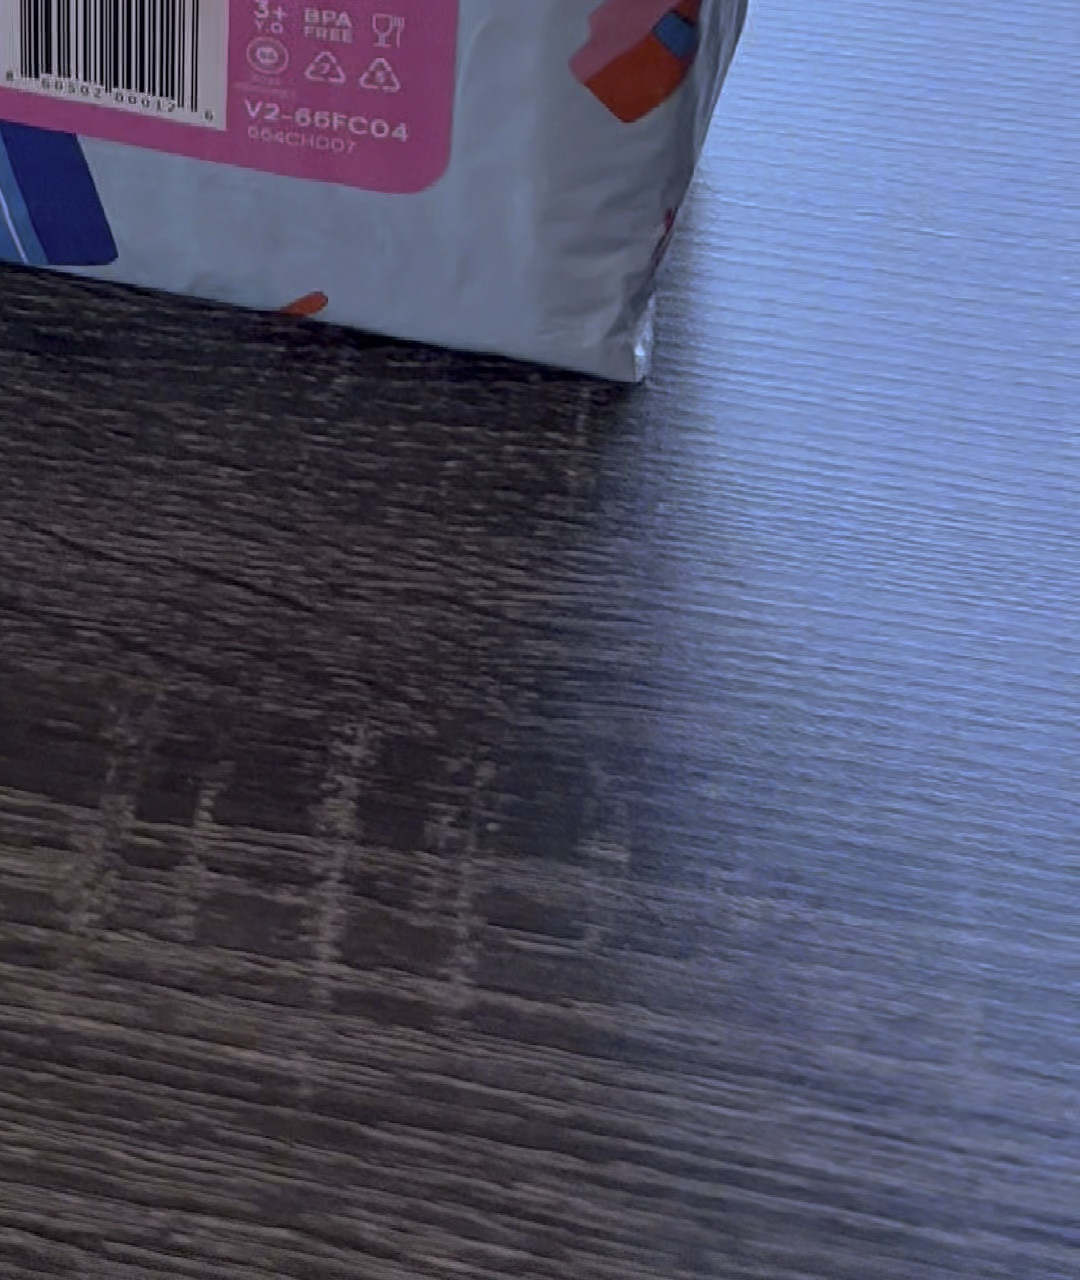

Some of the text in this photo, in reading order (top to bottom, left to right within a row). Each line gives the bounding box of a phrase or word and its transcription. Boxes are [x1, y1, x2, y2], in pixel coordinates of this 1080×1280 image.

[303, 7, 353, 28] BPA
[304, 25, 353, 44] FREE
[244, 99, 409, 143] V2-66FC04
